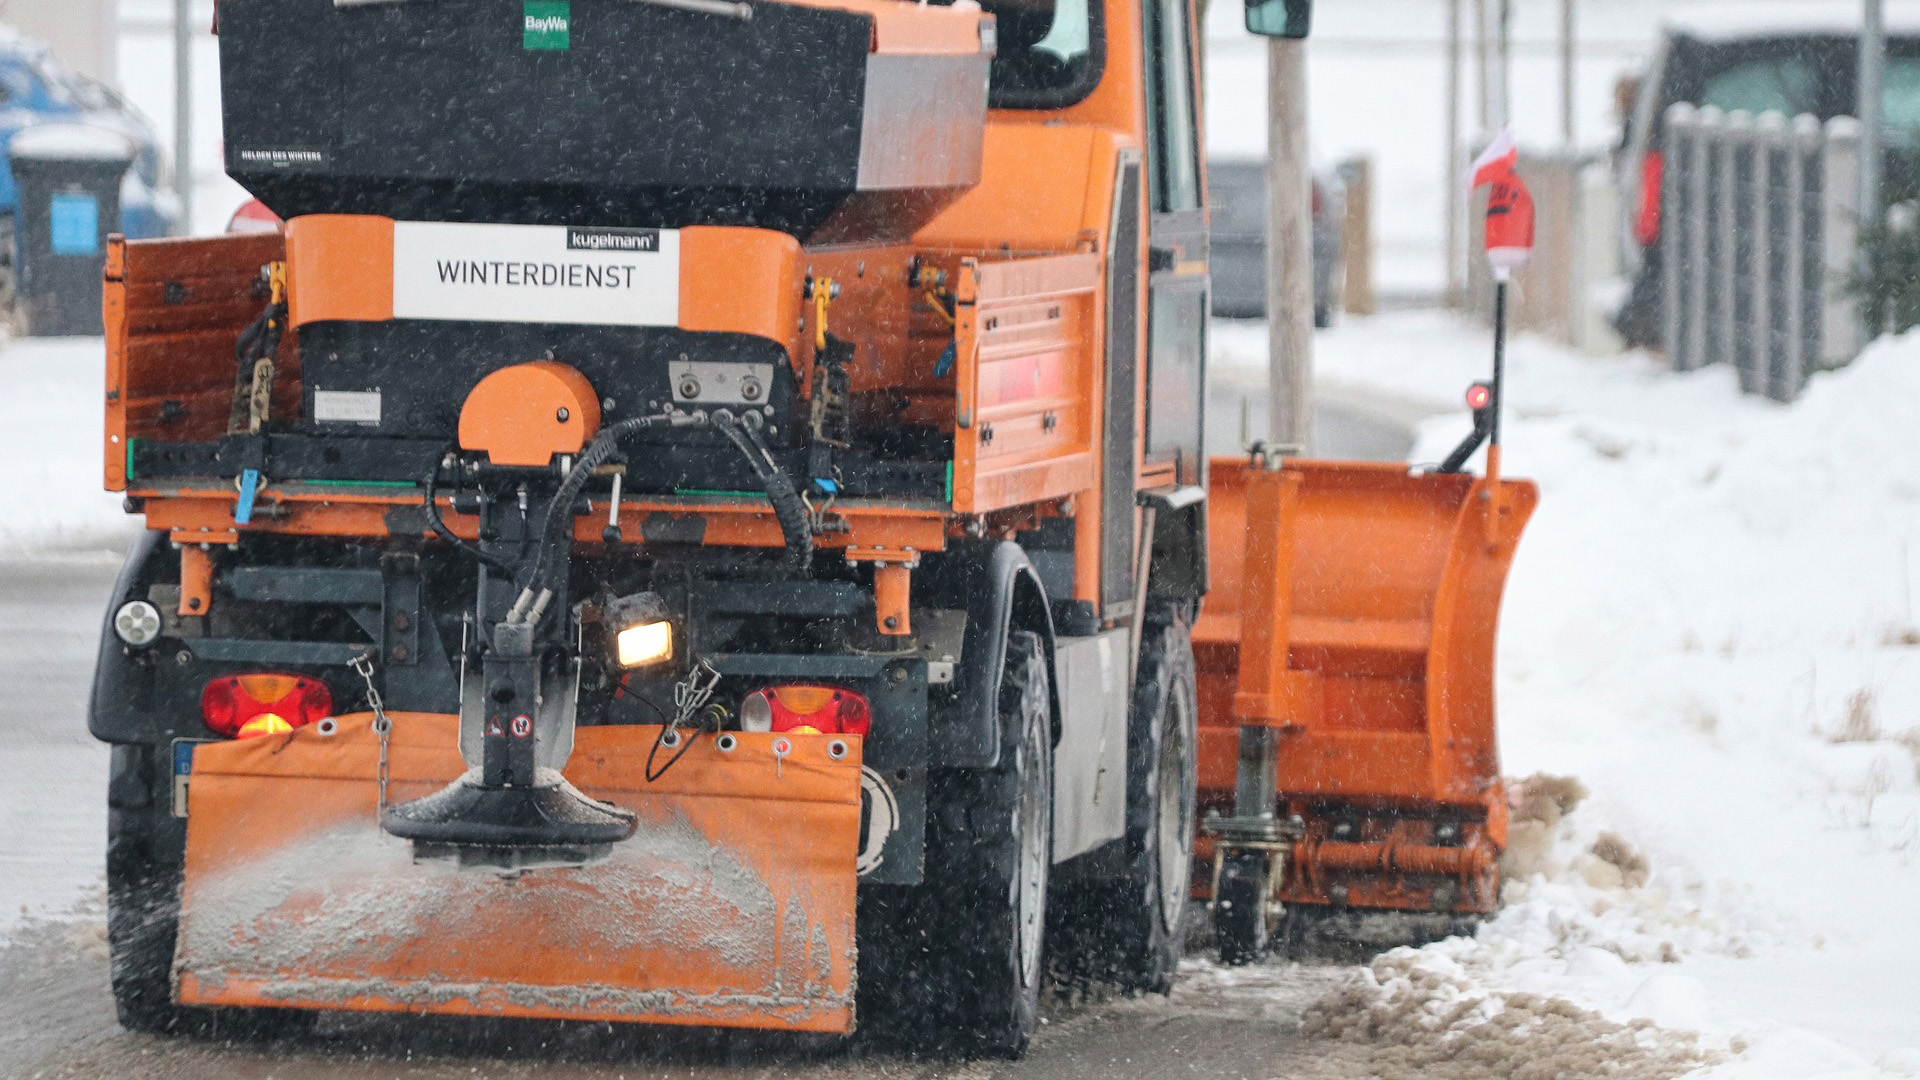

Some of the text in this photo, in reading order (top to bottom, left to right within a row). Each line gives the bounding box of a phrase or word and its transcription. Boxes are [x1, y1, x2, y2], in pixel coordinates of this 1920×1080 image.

[525, 15, 567, 34] BayWa
[241, 150, 321, 161] HELDEN DES WINTERS
[572, 231, 650, 250] kugelmann
[437, 259, 636, 289] WINTERDIENST
